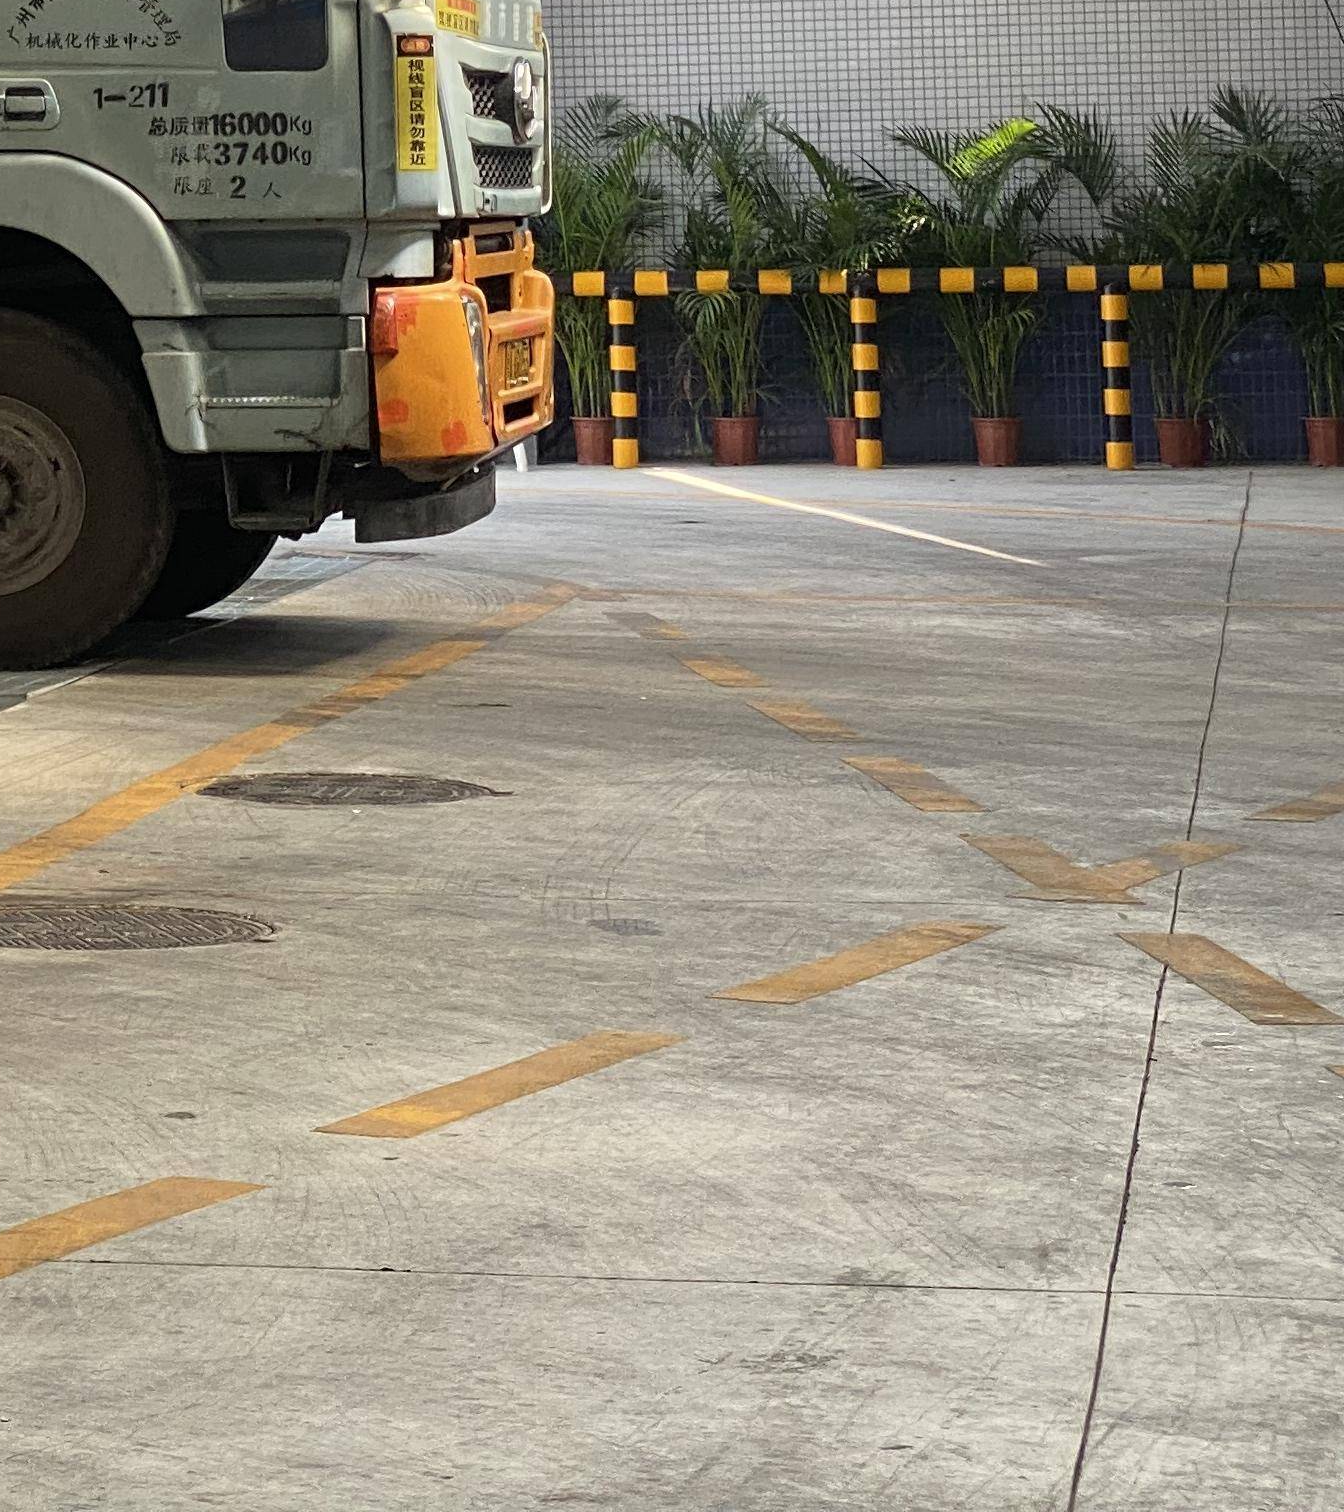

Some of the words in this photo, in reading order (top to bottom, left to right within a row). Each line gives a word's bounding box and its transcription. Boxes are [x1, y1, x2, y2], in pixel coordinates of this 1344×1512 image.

[25, 32, 160, 51] 机械化作业中心
[407, 59, 426, 167] 视线盲区请勿靠近
[229, 175, 247, 199] 2
